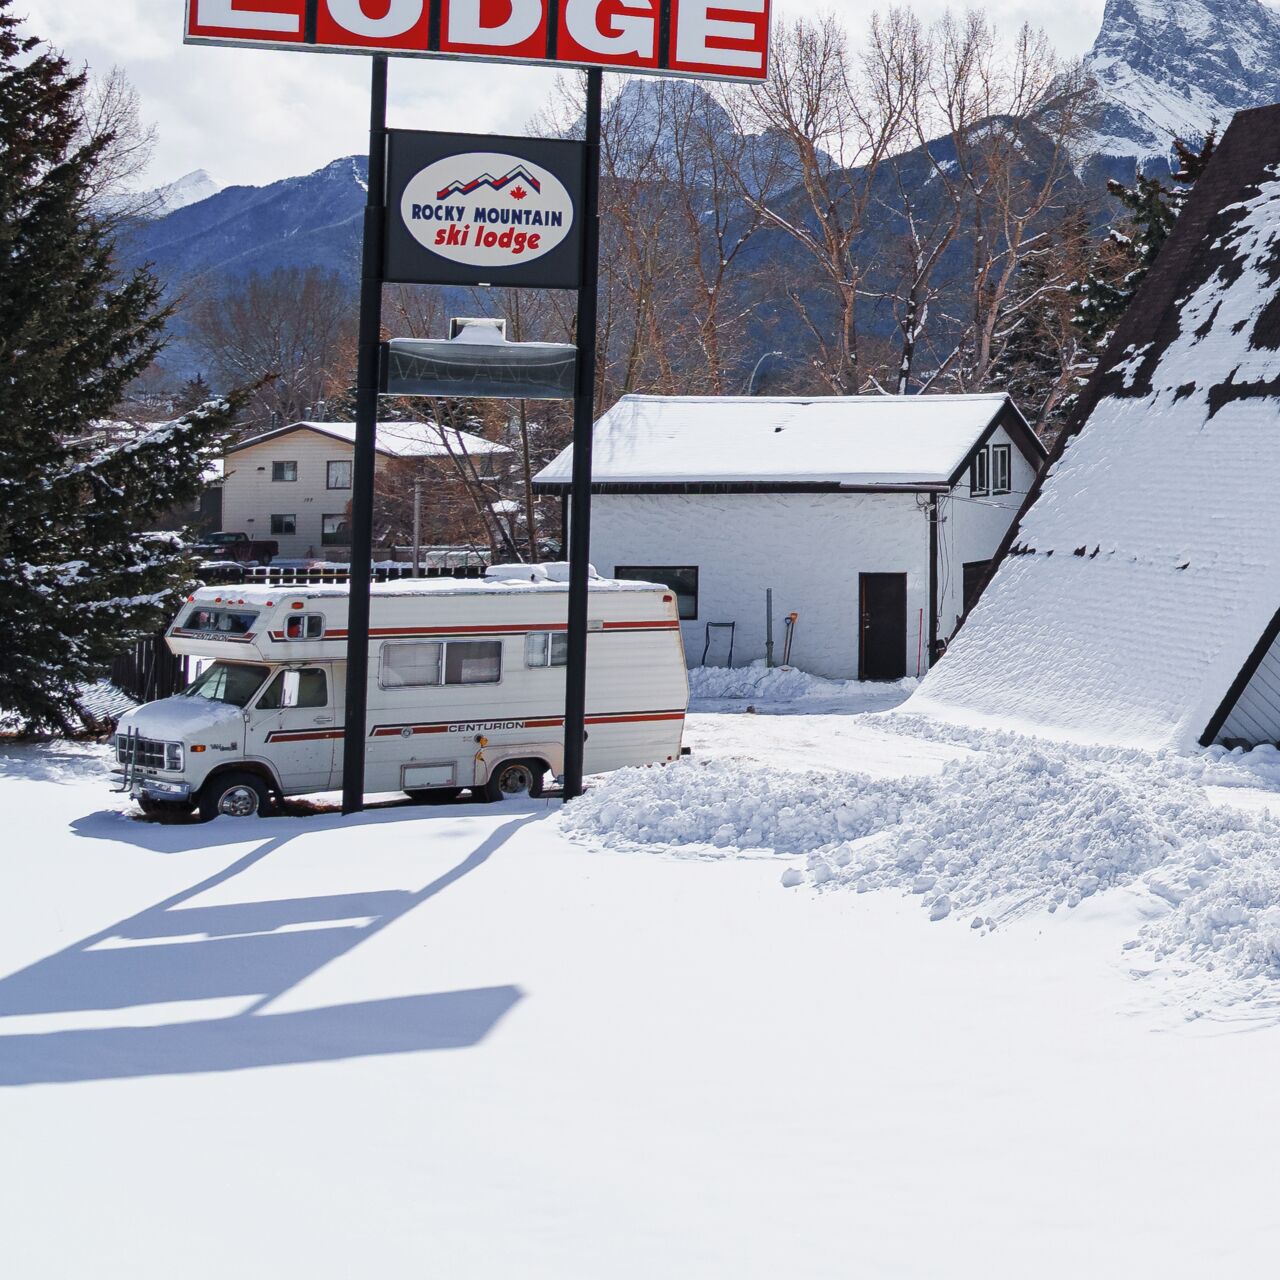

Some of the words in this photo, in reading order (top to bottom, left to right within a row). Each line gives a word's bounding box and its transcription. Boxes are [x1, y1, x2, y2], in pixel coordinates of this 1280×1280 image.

[411, 203, 466, 222] ROCKY
[473, 207, 563, 227] MOUNTAIN
[434, 223, 471, 246] ski
[474, 225, 541, 254] lodge
[394, 355, 570, 387] VACANCY
[448, 721, 525, 733] CENTURION
